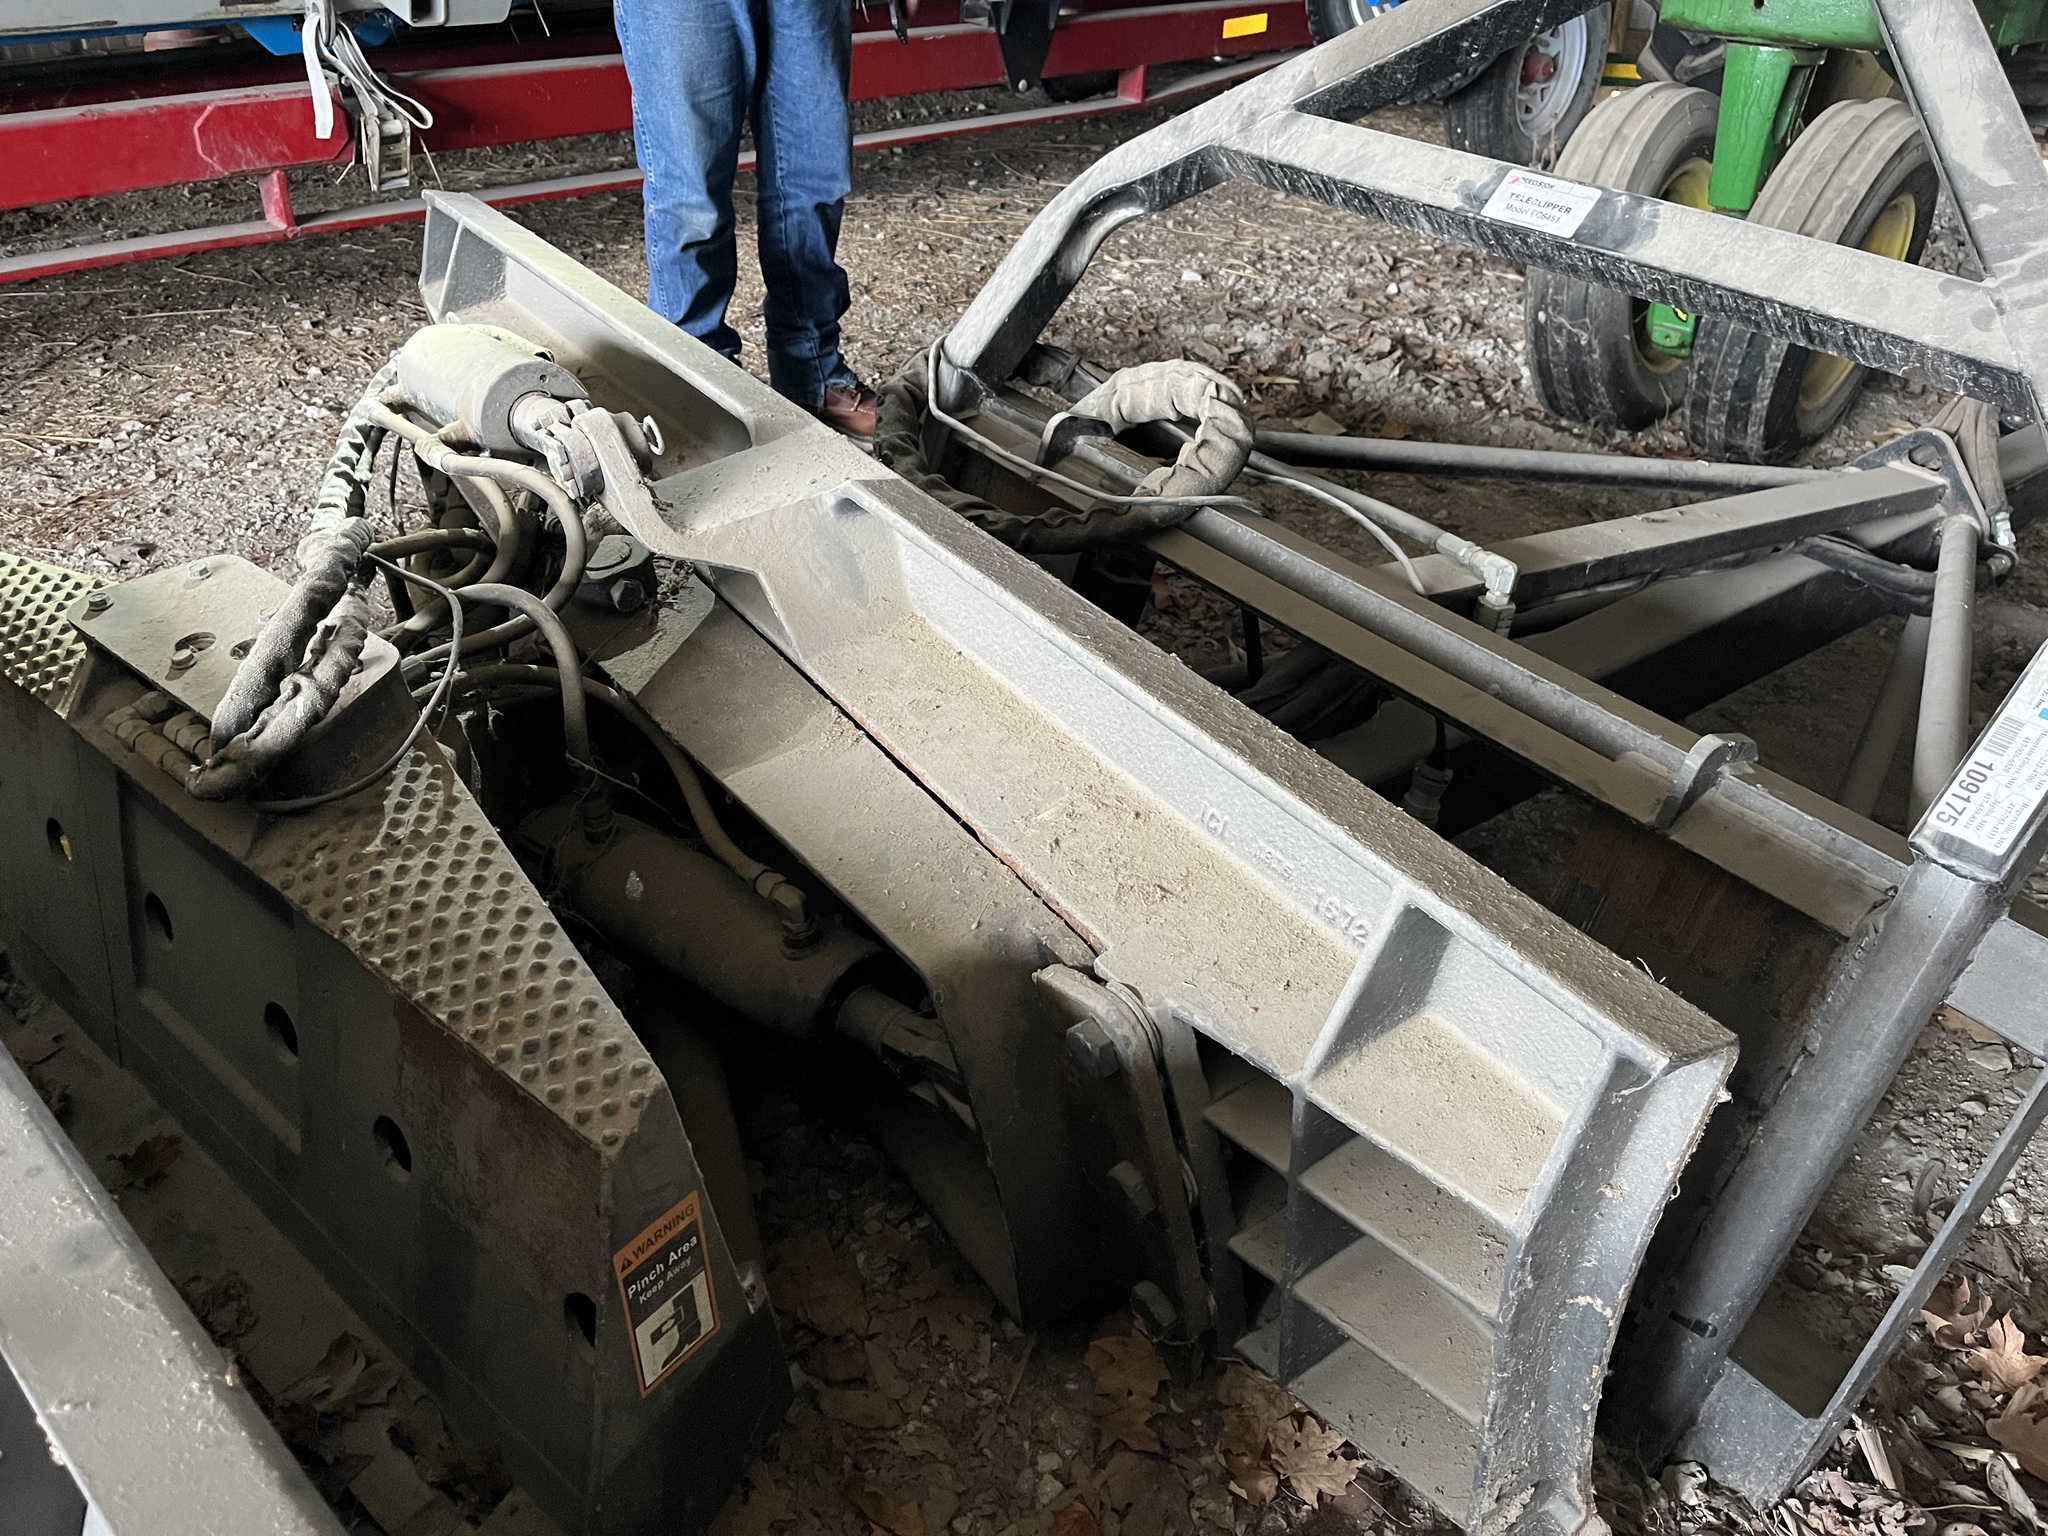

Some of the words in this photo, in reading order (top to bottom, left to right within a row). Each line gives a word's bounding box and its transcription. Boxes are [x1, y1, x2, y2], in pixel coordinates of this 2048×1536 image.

[1504, 203, 1530, 215] Model
[1509, 192, 1572, 214] TELECLIPPER
[1935, 760, 1994, 827] 109175
[2004, 776, 2017, 790] MO
[1975, 817, 1988, 831] MO
[1993, 834, 2006, 849] MO
[631, 1203, 695, 1259] WARNING
[627, 1263, 665, 1299] Pinch
[668, 1236, 697, 1266] Area
[639, 1280, 664, 1304] Keep
[666, 1256, 692, 1281] Away
